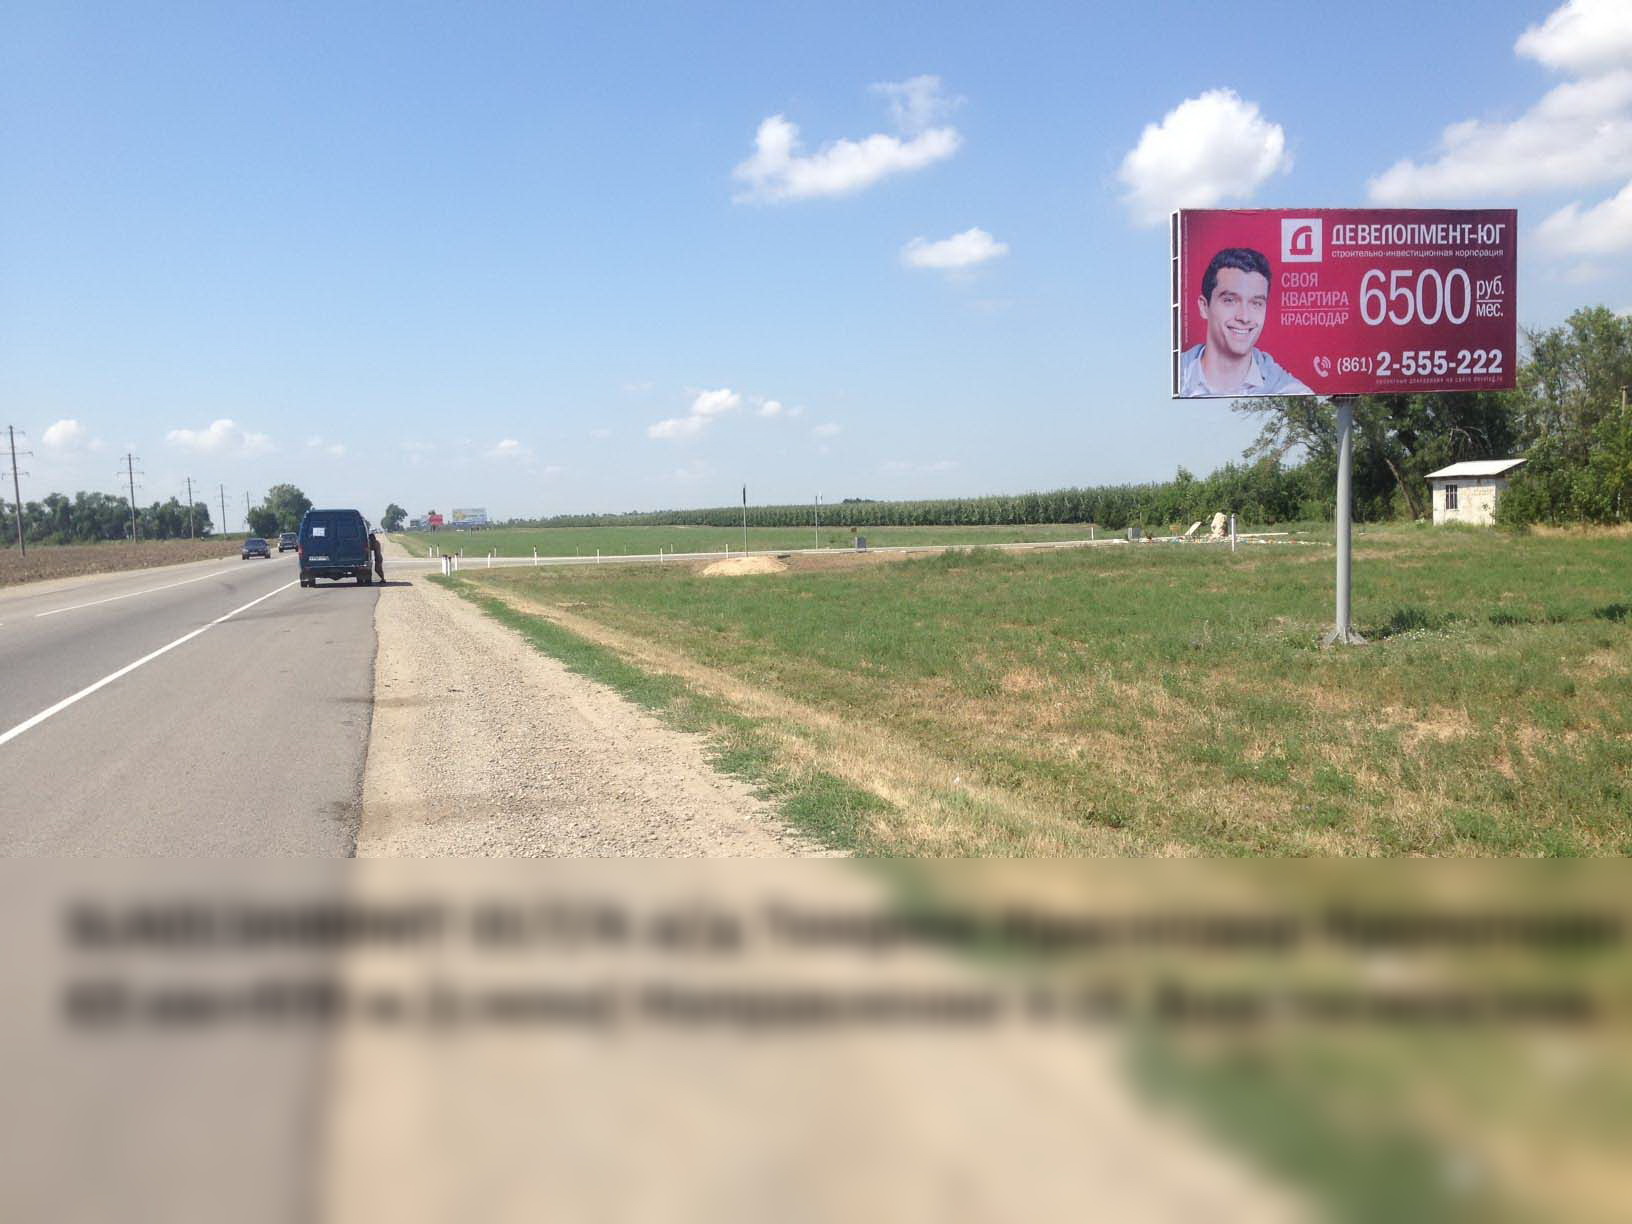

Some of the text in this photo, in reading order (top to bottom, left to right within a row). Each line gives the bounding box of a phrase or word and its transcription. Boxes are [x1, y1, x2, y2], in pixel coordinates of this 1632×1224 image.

[1331, 223, 1506, 245] ДЕВЕЛОПМЕНТ-ЮГ
[1331, 249, 1504, 258] строительно-инвестиционная корпорация
[1281, 272, 1319, 288] СВОЯ
[1476, 275, 1505, 300] руб.
[1281, 291, 1350, 307] КВАРТИРА
[1360, 268, 1472, 326] 6500
[1476, 303, 1504, 317] мес.
[1281, 312, 1350, 327] КРАСНОДАР
[1337, 349, 1503, 377] (861) 2-555-222
